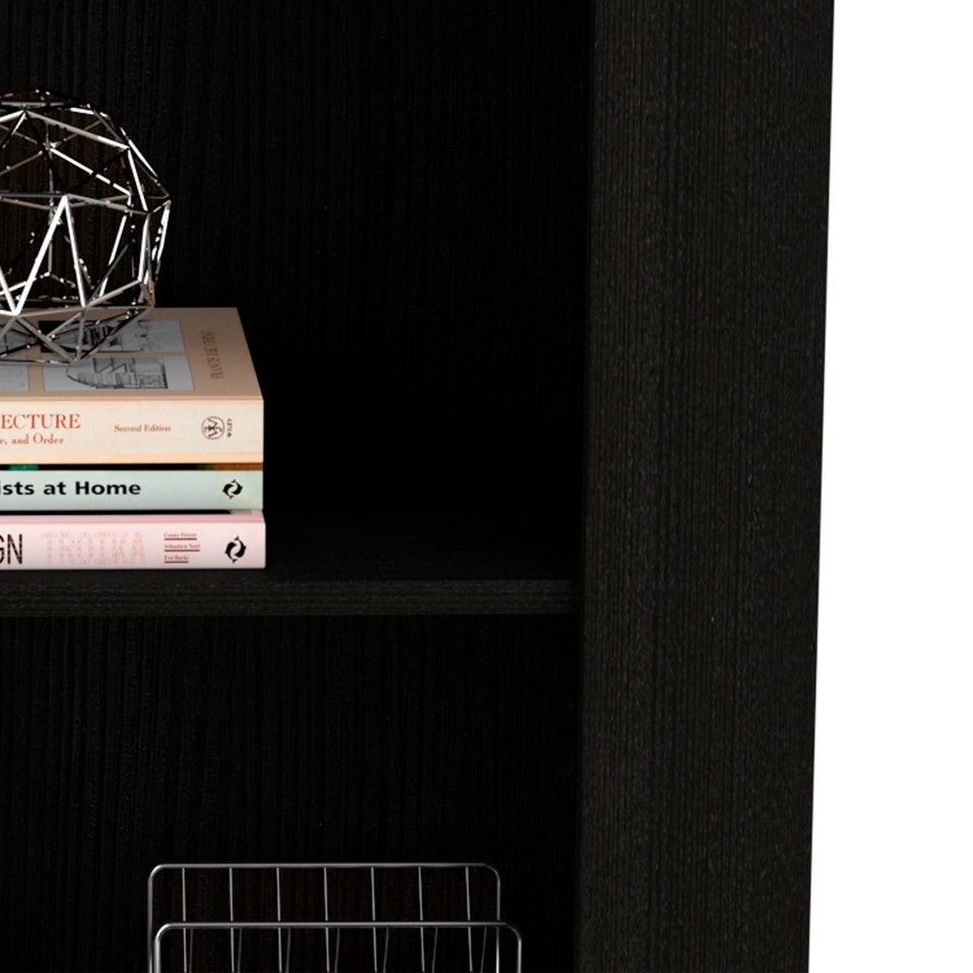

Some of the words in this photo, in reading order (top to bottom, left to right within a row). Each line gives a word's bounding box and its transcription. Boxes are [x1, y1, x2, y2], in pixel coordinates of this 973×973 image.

[144, 424, 171, 432] Edition
[11, 434, 29, 445] and
[32, 432, 64, 445] Order
[43, 481, 67, 495] at
[75, 481, 141, 496] Home
[41, 532, 147, 565] TROIKA
